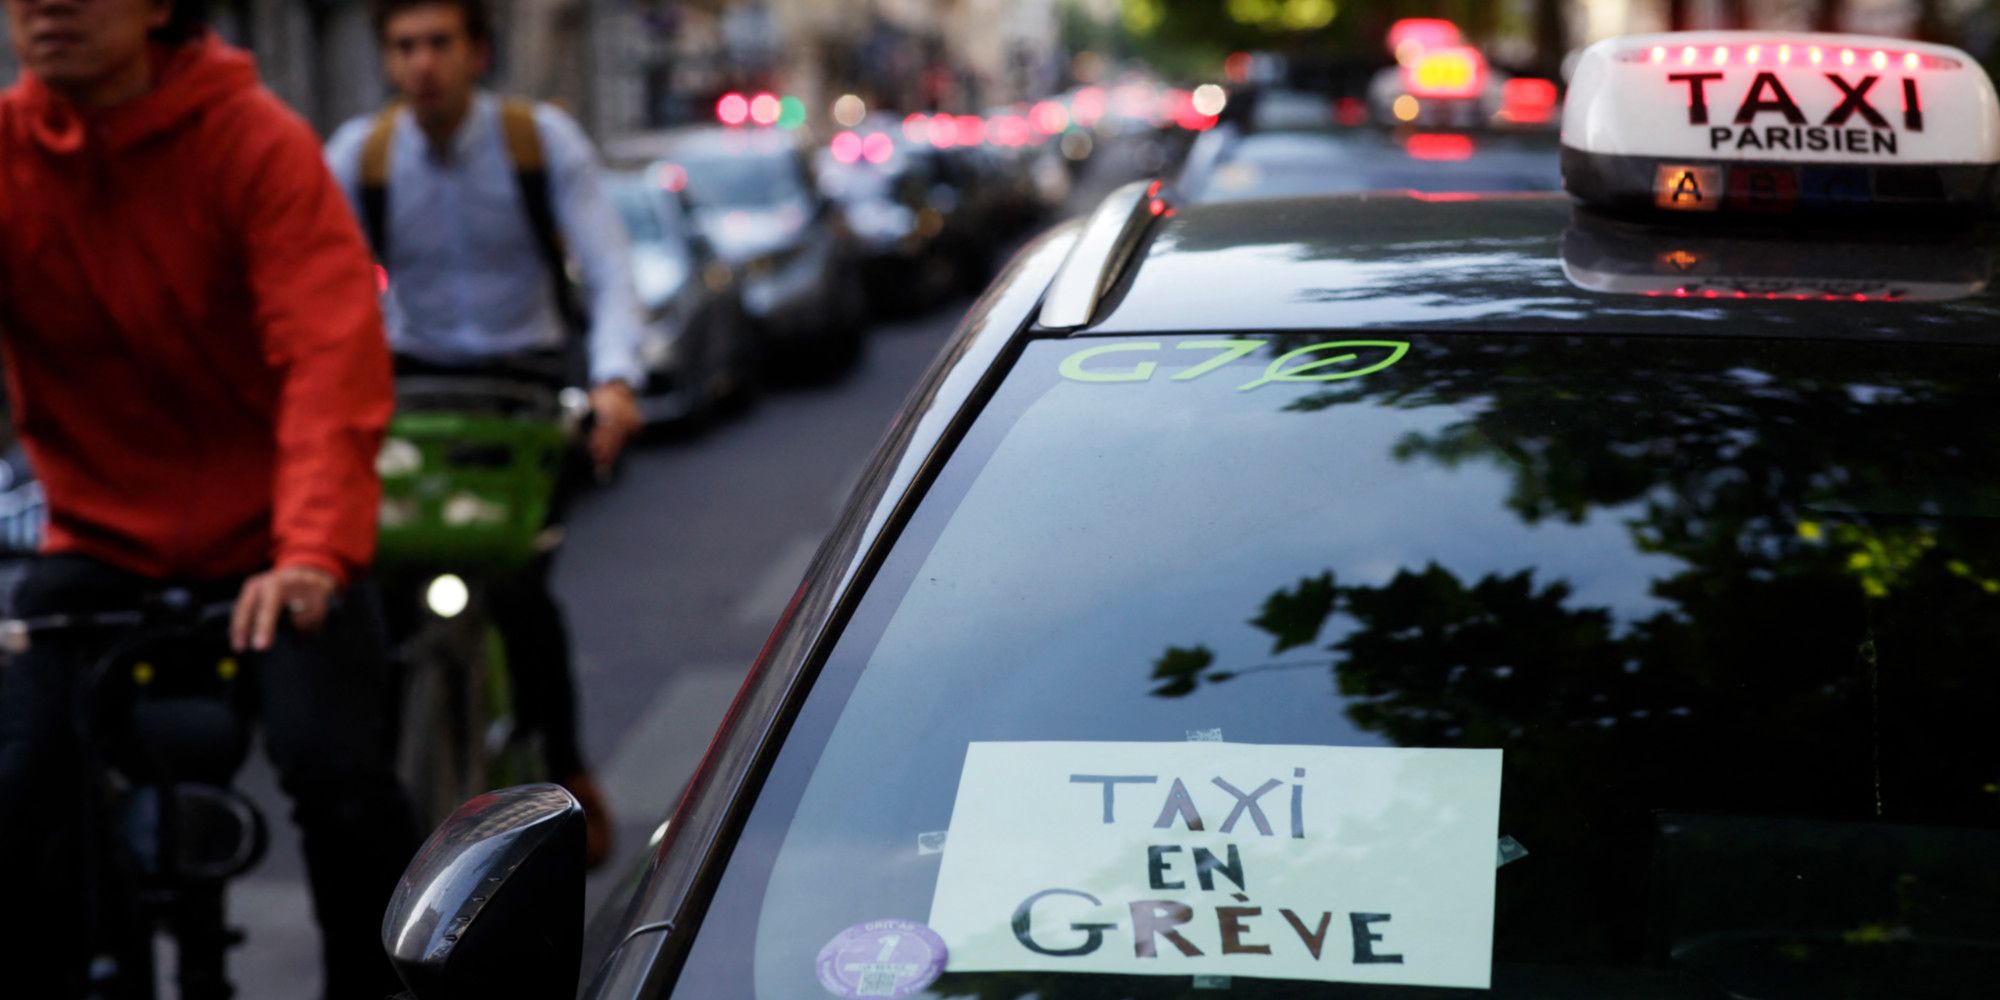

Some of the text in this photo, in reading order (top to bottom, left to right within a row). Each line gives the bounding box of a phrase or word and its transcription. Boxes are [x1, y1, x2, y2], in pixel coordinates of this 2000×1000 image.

[1668, 71, 1924, 132] TAXI
[1709, 126, 1898, 155] PARISIEN
[1672, 171, 1702, 203] A
[1147, 844, 1246, 892] EN
[1010, 888, 1404, 965] GRÈVE
